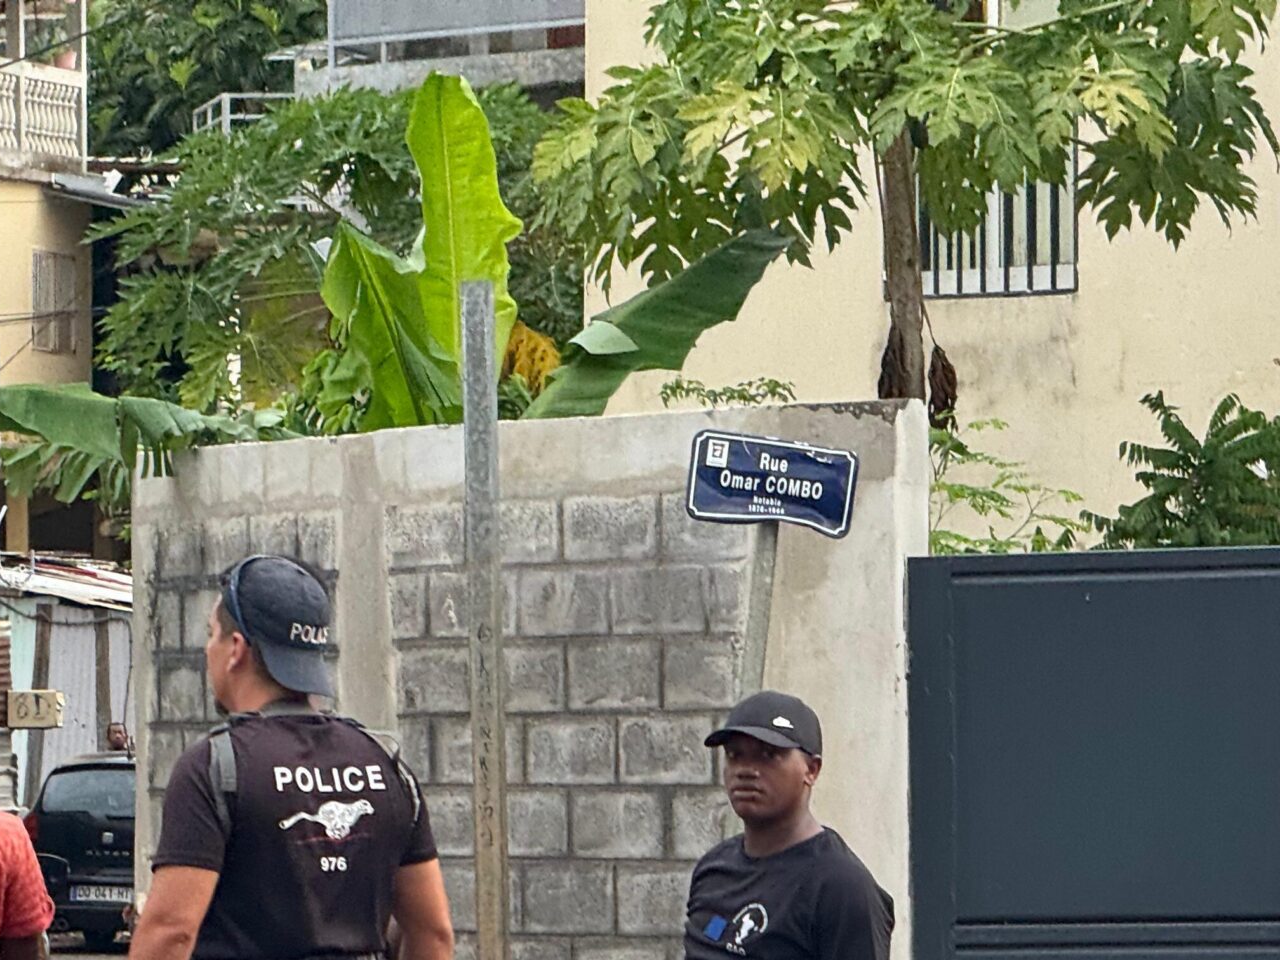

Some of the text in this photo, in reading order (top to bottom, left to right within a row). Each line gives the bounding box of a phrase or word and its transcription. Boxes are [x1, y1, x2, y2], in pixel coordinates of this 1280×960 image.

[759, 452, 789, 473] Rue
[720, 469, 823, 500] Omar COMBO
[273, 765, 387, 792] POLICE
[320, 857, 348, 872] 976
